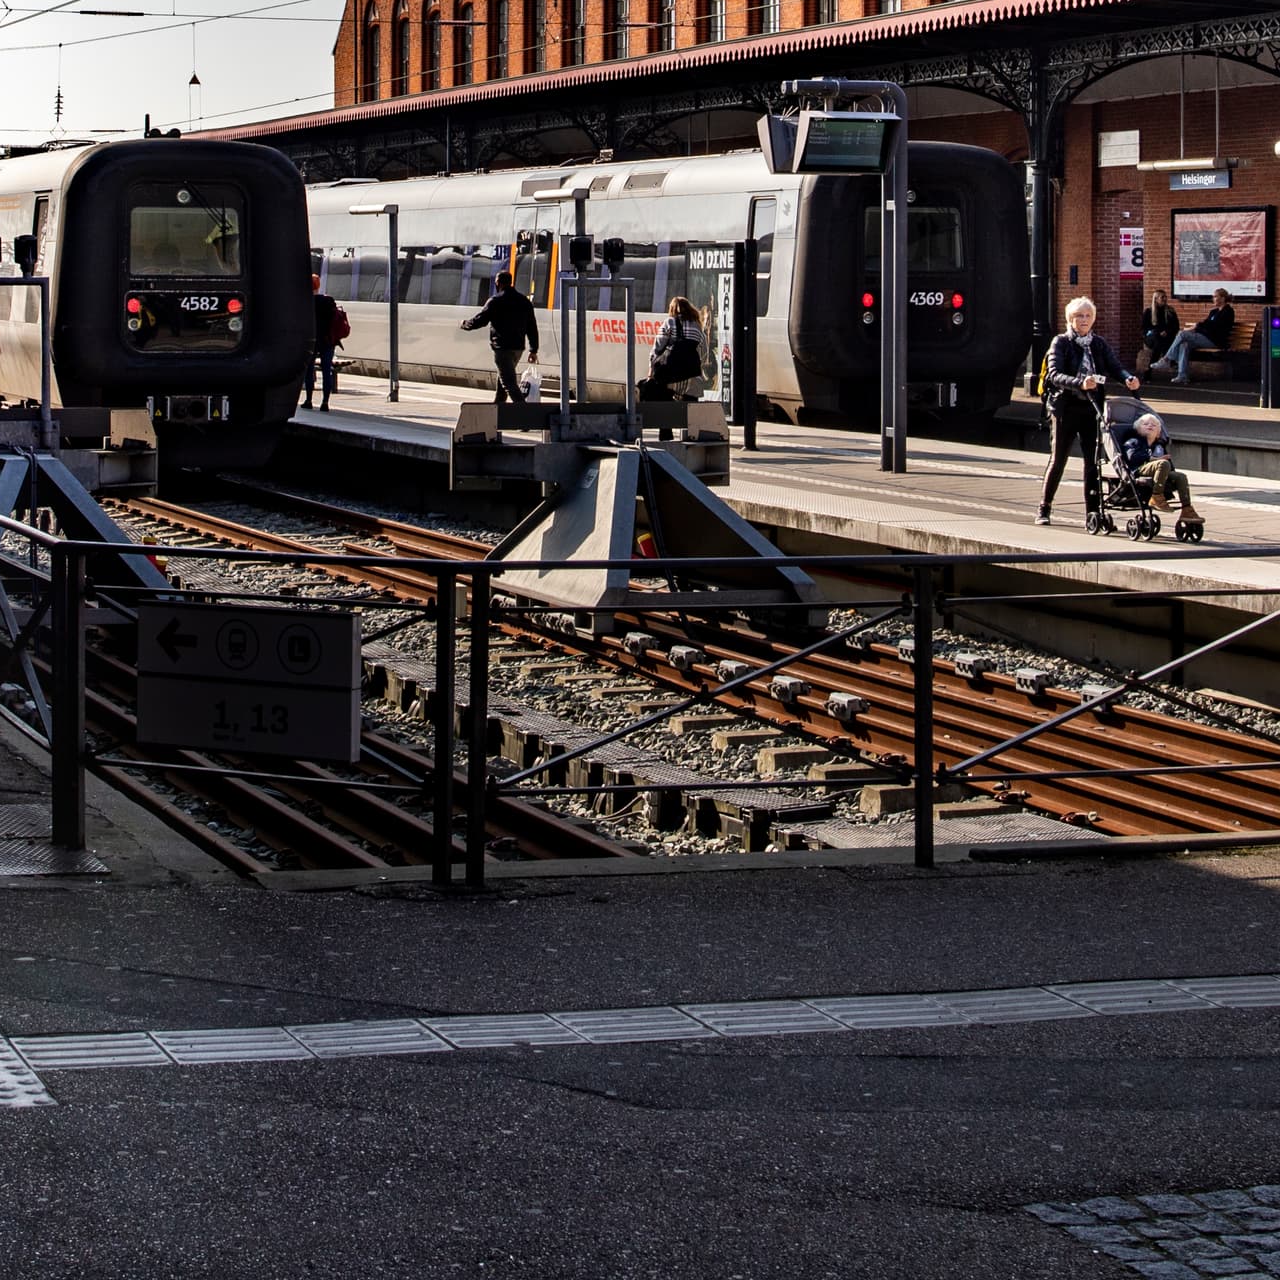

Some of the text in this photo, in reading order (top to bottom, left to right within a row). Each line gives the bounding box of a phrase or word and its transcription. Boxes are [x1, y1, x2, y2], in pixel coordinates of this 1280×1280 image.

[706, 250, 734, 269] DINE
[180, 296, 219, 311] 4582
[910, 291, 944, 306] 4369
[249, 703, 289, 734] 13
